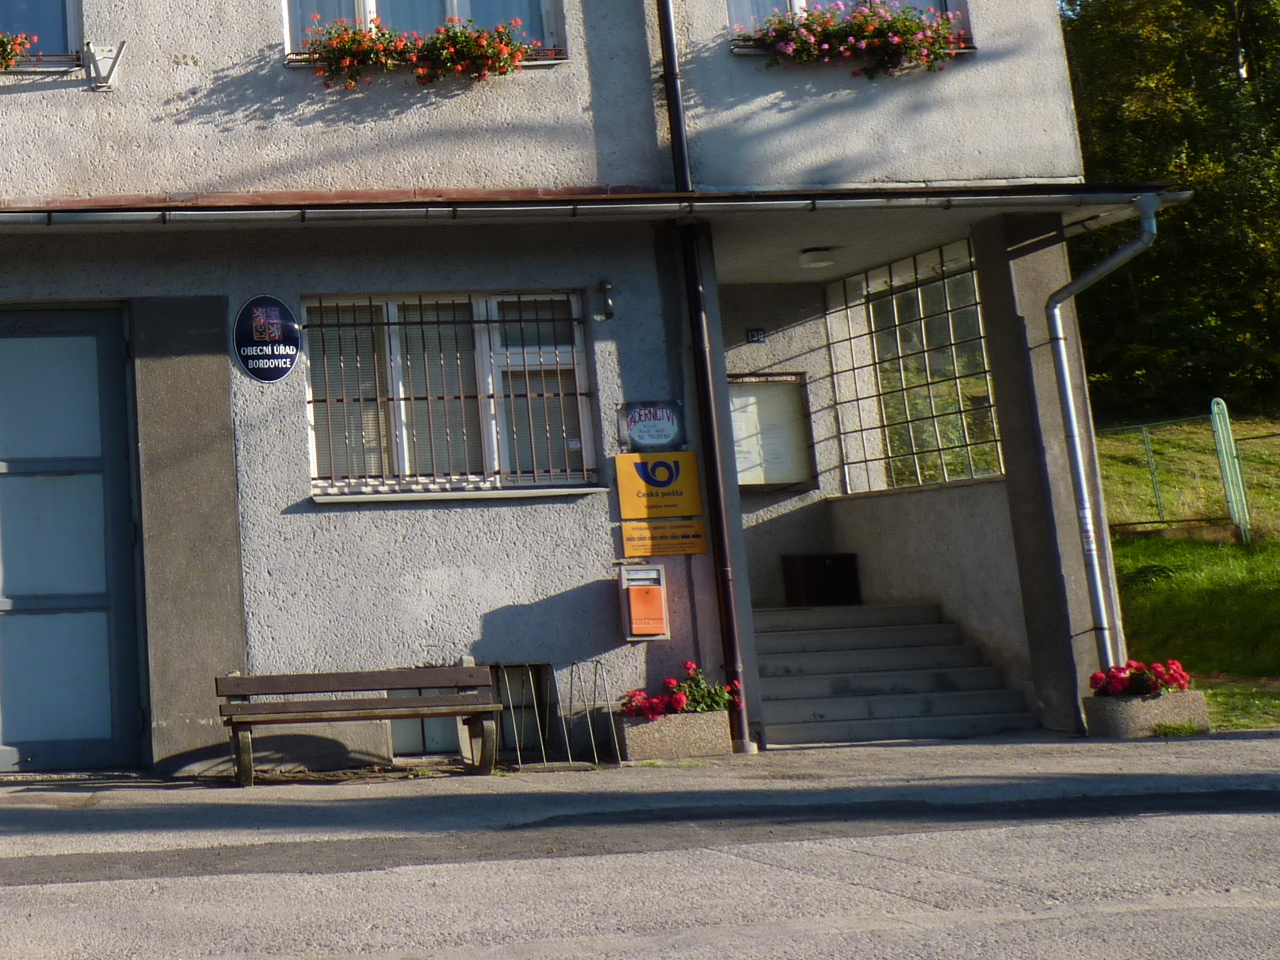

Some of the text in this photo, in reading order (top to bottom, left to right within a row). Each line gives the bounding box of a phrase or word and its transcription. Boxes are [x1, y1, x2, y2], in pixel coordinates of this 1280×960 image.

[240, 343, 297, 356] OBECNÍ ÚŘAD
[248, 358, 292, 369] BORDOVICE
[636, 489, 684, 499] Česká pošta
